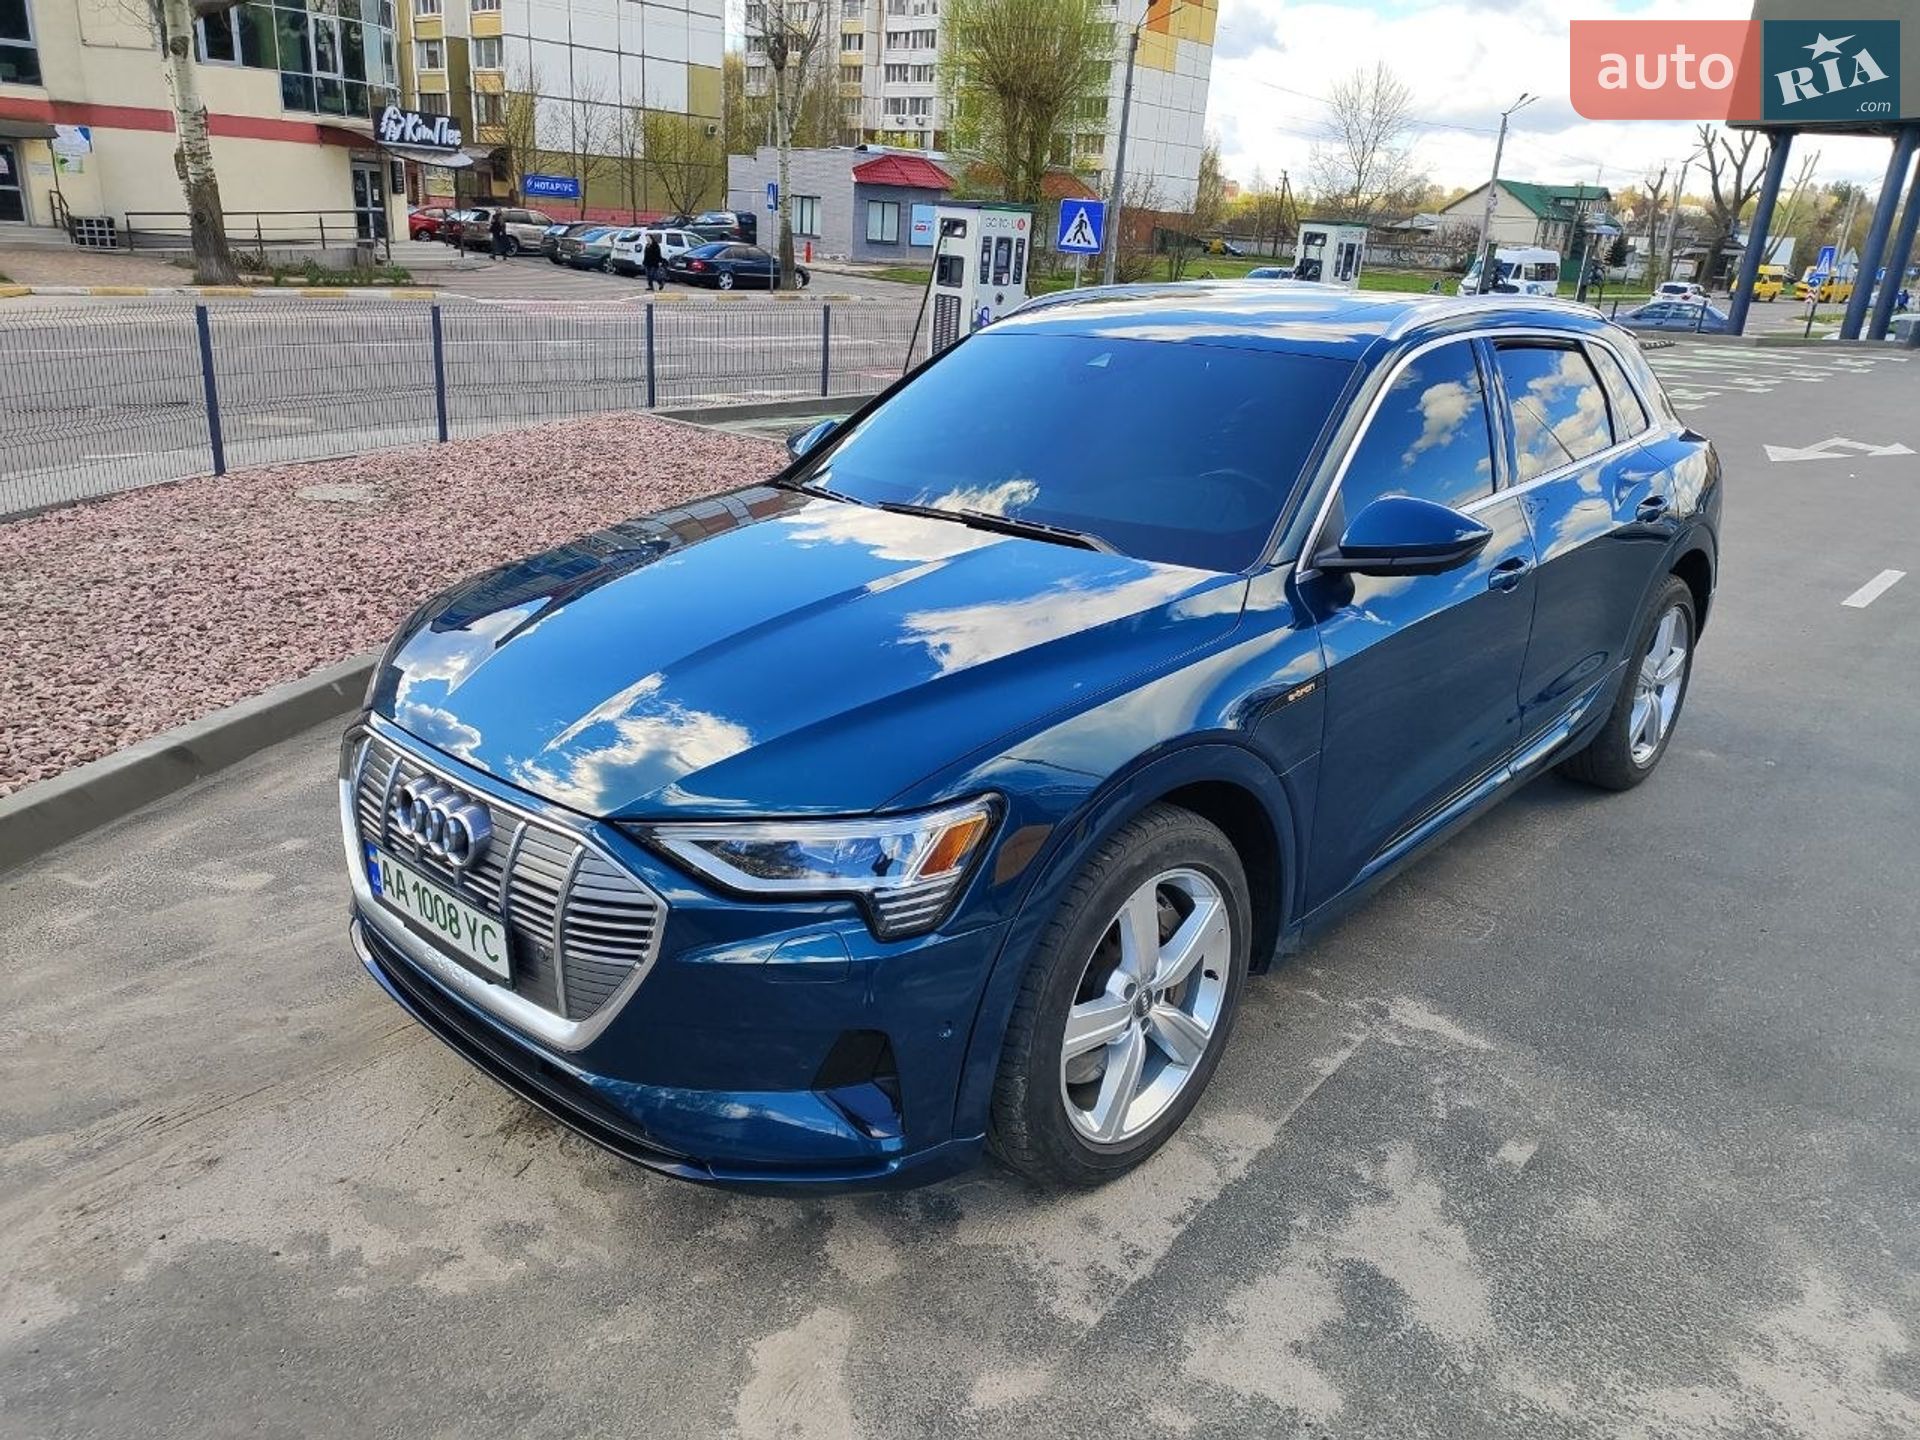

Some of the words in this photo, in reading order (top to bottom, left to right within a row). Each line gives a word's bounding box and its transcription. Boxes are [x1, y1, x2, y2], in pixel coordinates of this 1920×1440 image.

[534, 180, 574, 192] НОТАРІУС
[382, 859, 411, 909] AA
[412, 880, 462, 941] 1008
[463, 911, 500, 963] YC
